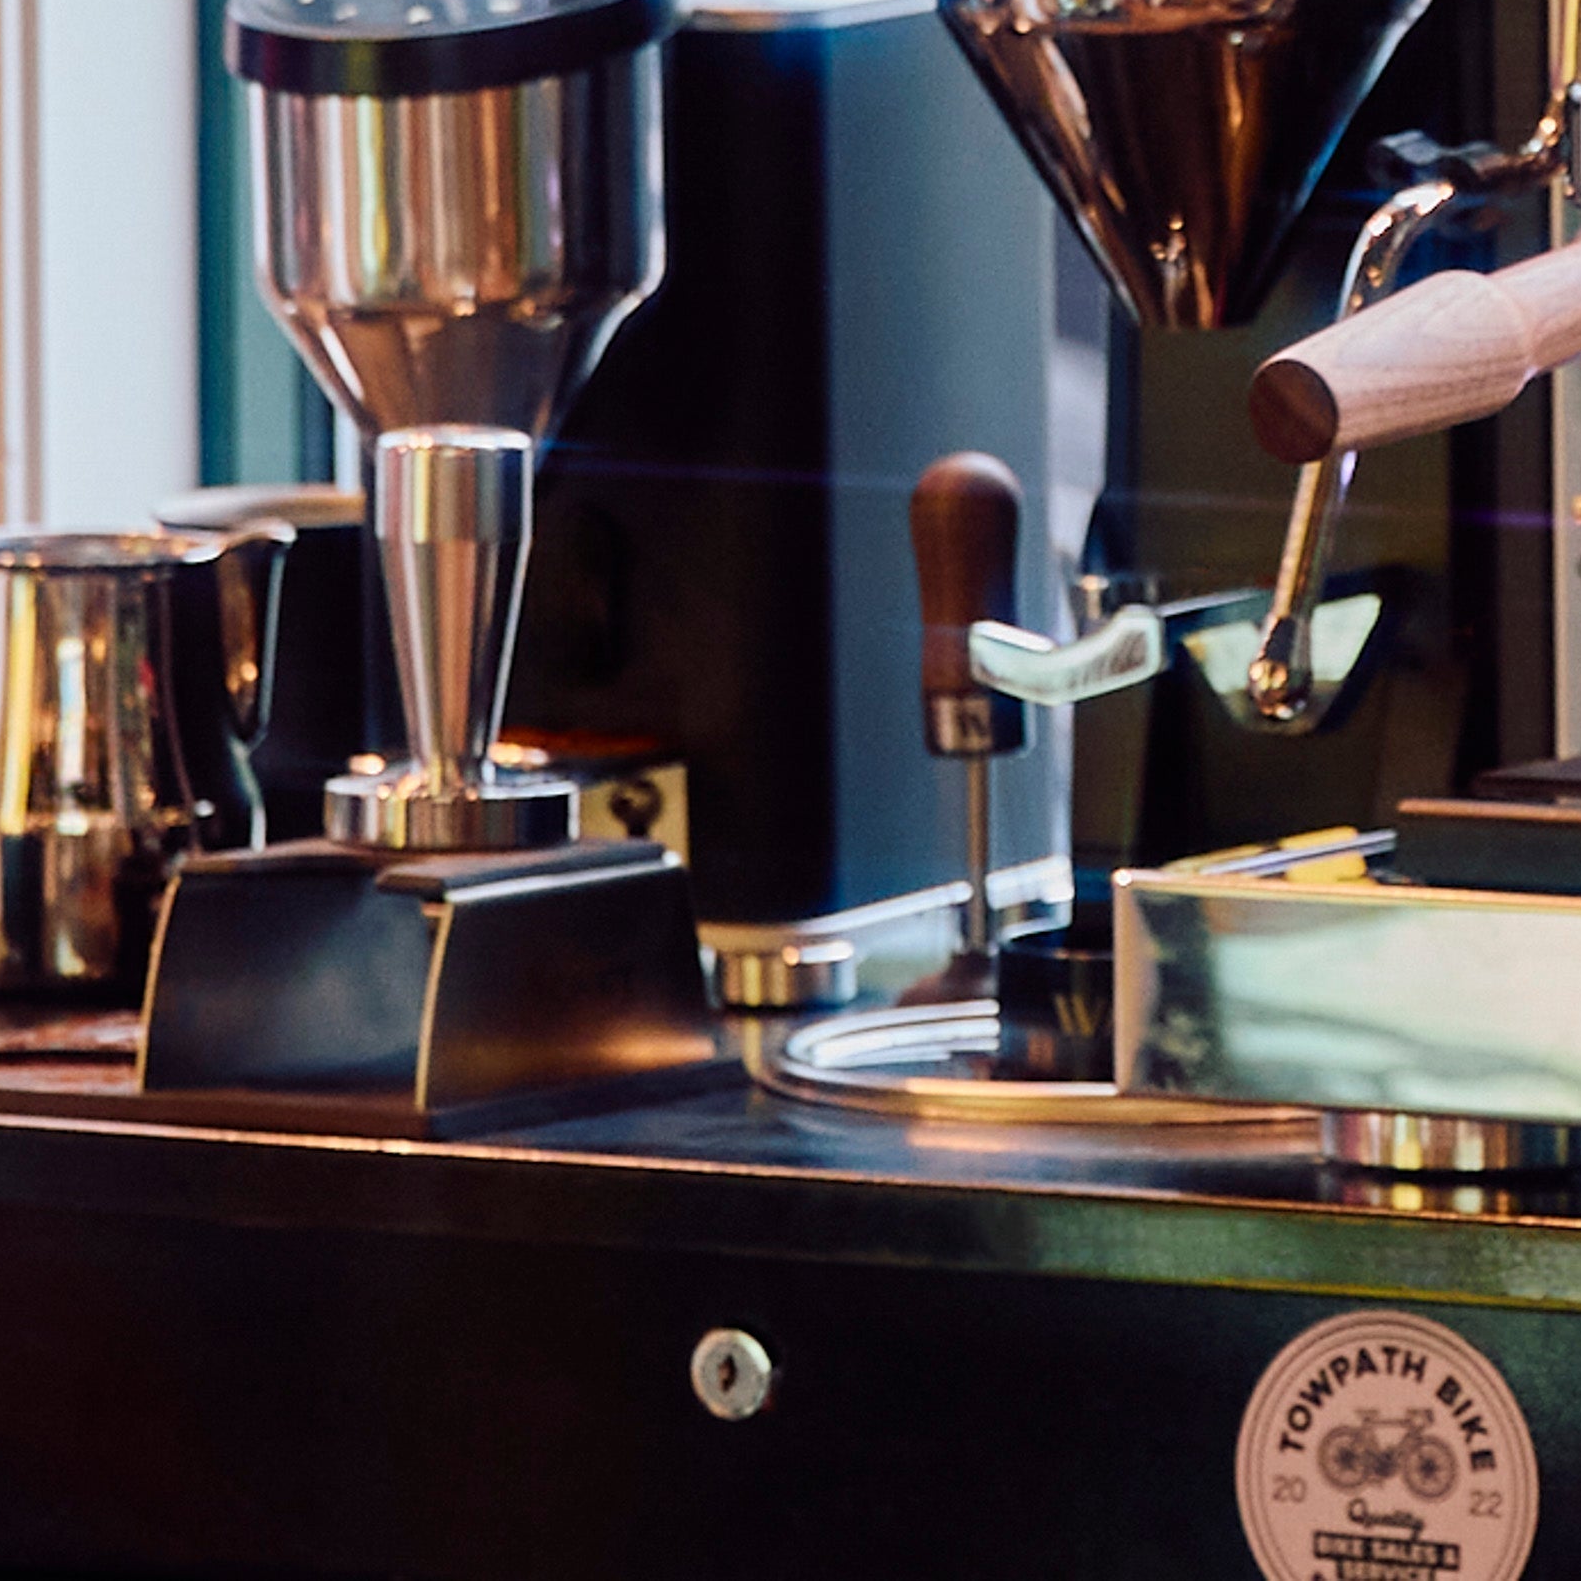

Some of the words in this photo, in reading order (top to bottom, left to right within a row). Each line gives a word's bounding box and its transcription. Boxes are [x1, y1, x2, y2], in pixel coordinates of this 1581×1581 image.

[1279, 1346, 1429, 1455] TOWPATH
[1435, 1375, 1497, 1472] BIKE
[1272, 1475, 1307, 1504] 20
[1470, 1490, 1502, 1519] 22
